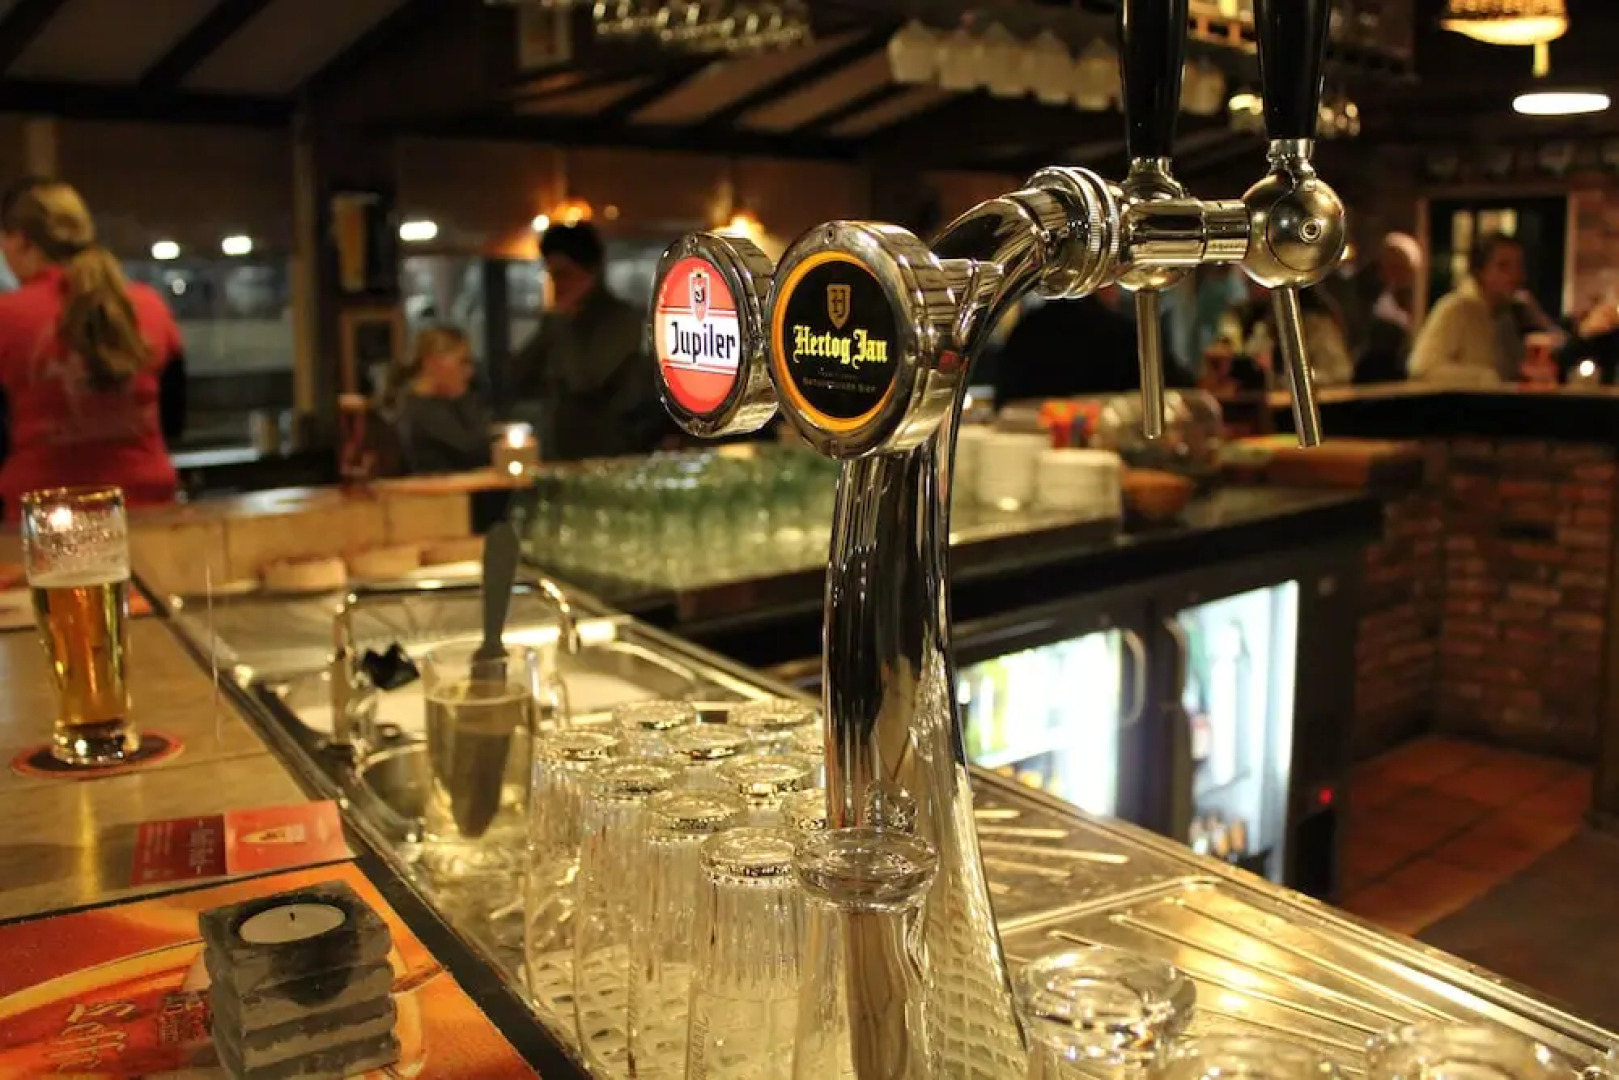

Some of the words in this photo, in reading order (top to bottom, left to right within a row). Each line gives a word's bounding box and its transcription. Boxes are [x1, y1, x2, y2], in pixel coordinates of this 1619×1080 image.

[670, 321, 736, 364] Jupiler
[793, 324, 851, 365] Hertog
[852, 328, 888, 370] Jan
